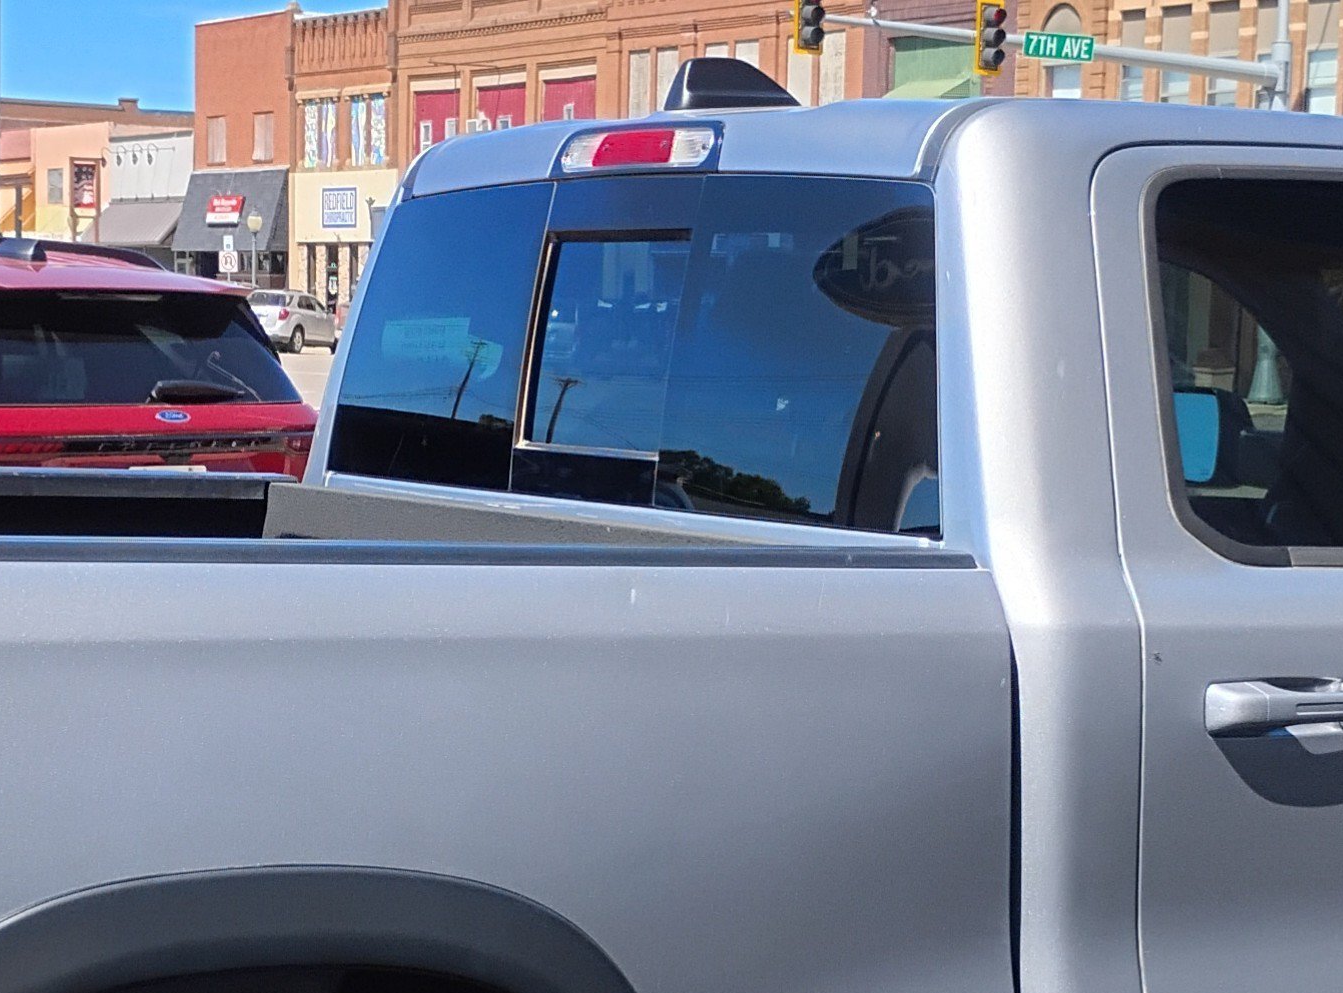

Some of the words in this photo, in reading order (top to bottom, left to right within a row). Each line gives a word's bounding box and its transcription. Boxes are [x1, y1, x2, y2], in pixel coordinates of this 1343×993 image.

[1028, 35, 1057, 56] 7TH
[1061, 37, 1091, 59] AVE
[324, 192, 354, 210] REDFIELD
